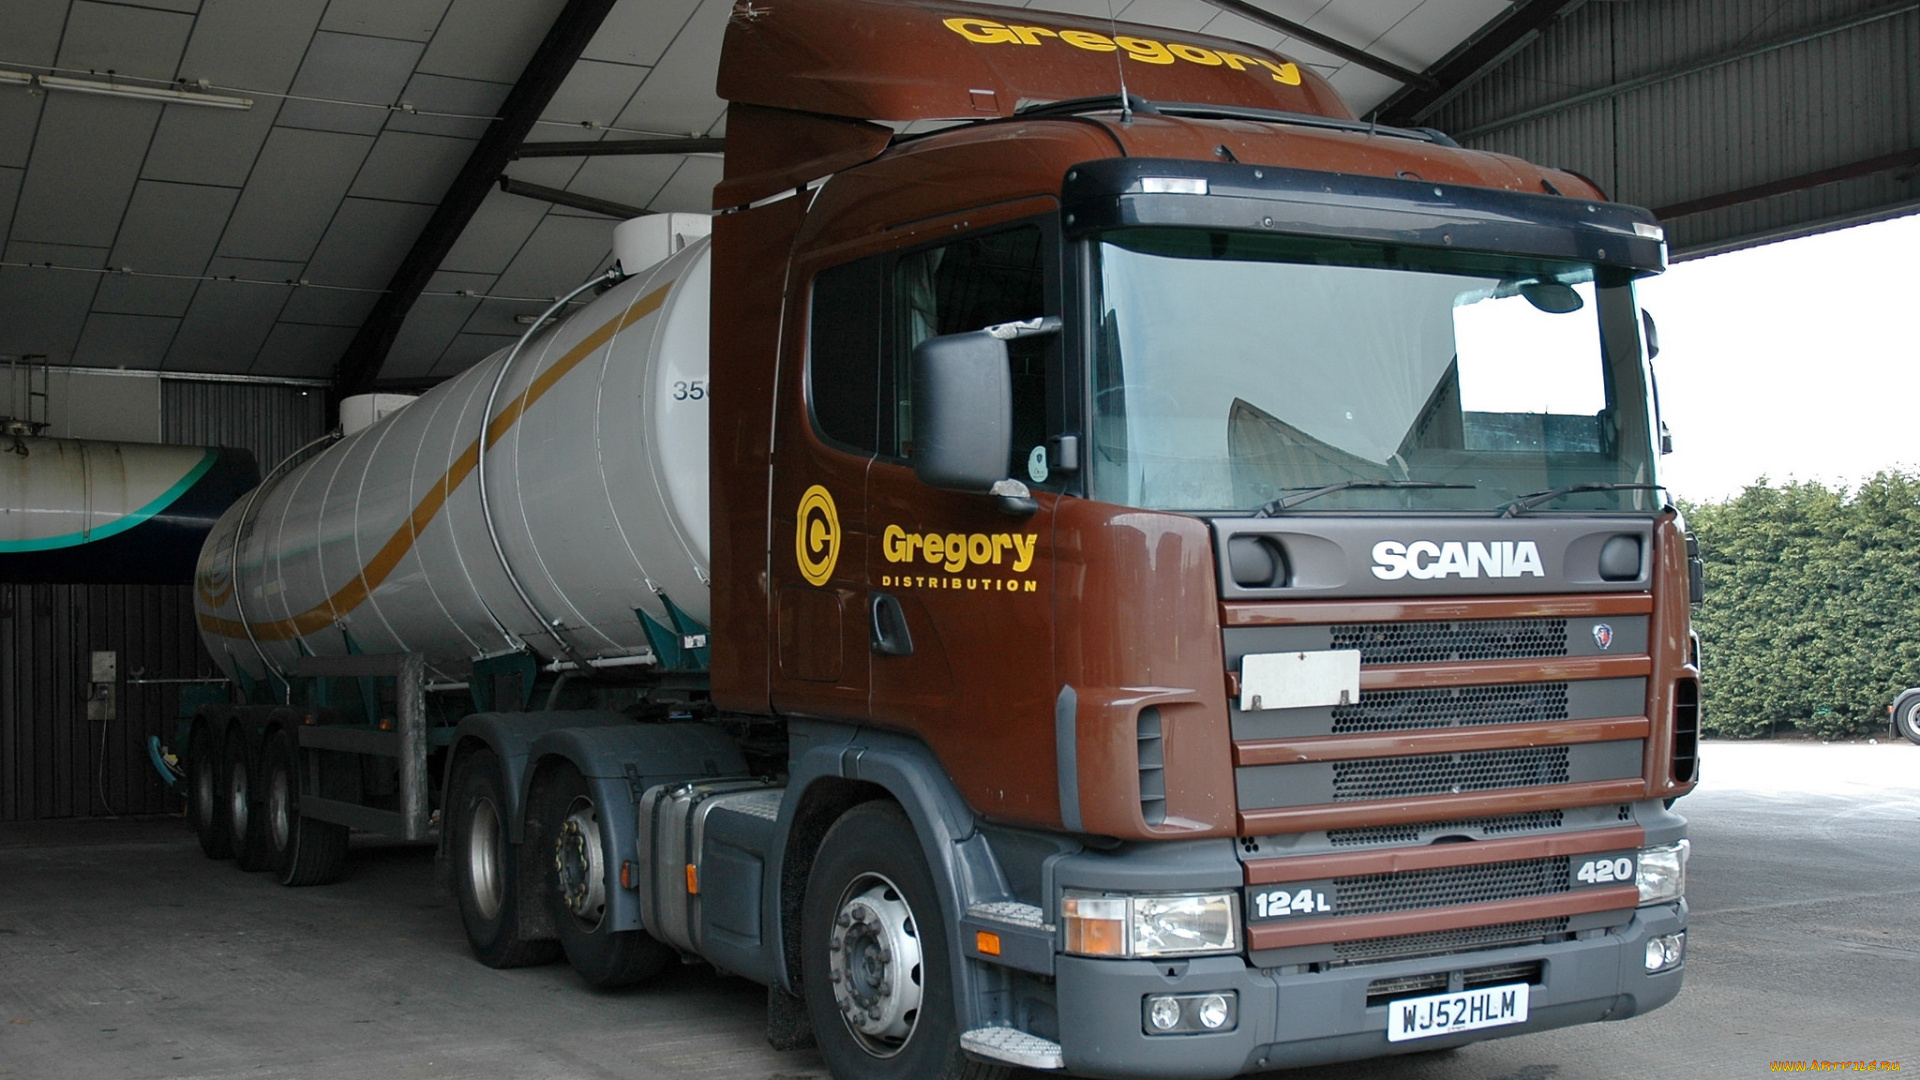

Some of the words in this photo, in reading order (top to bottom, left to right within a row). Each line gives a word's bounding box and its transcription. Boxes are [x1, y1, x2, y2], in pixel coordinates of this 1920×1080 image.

[942, 17, 1302, 86] Gregory
[673, 380, 709, 401] 35
[882, 524, 1038, 573] Gregory
[1372, 540, 1545, 580] SCANIA
[882, 575, 1037, 592] DISTRIBUTION
[1577, 858, 1633, 882] 420
[1256, 889, 1331, 917] 124L
[1403, 990, 1516, 1033] WJ52HLM
